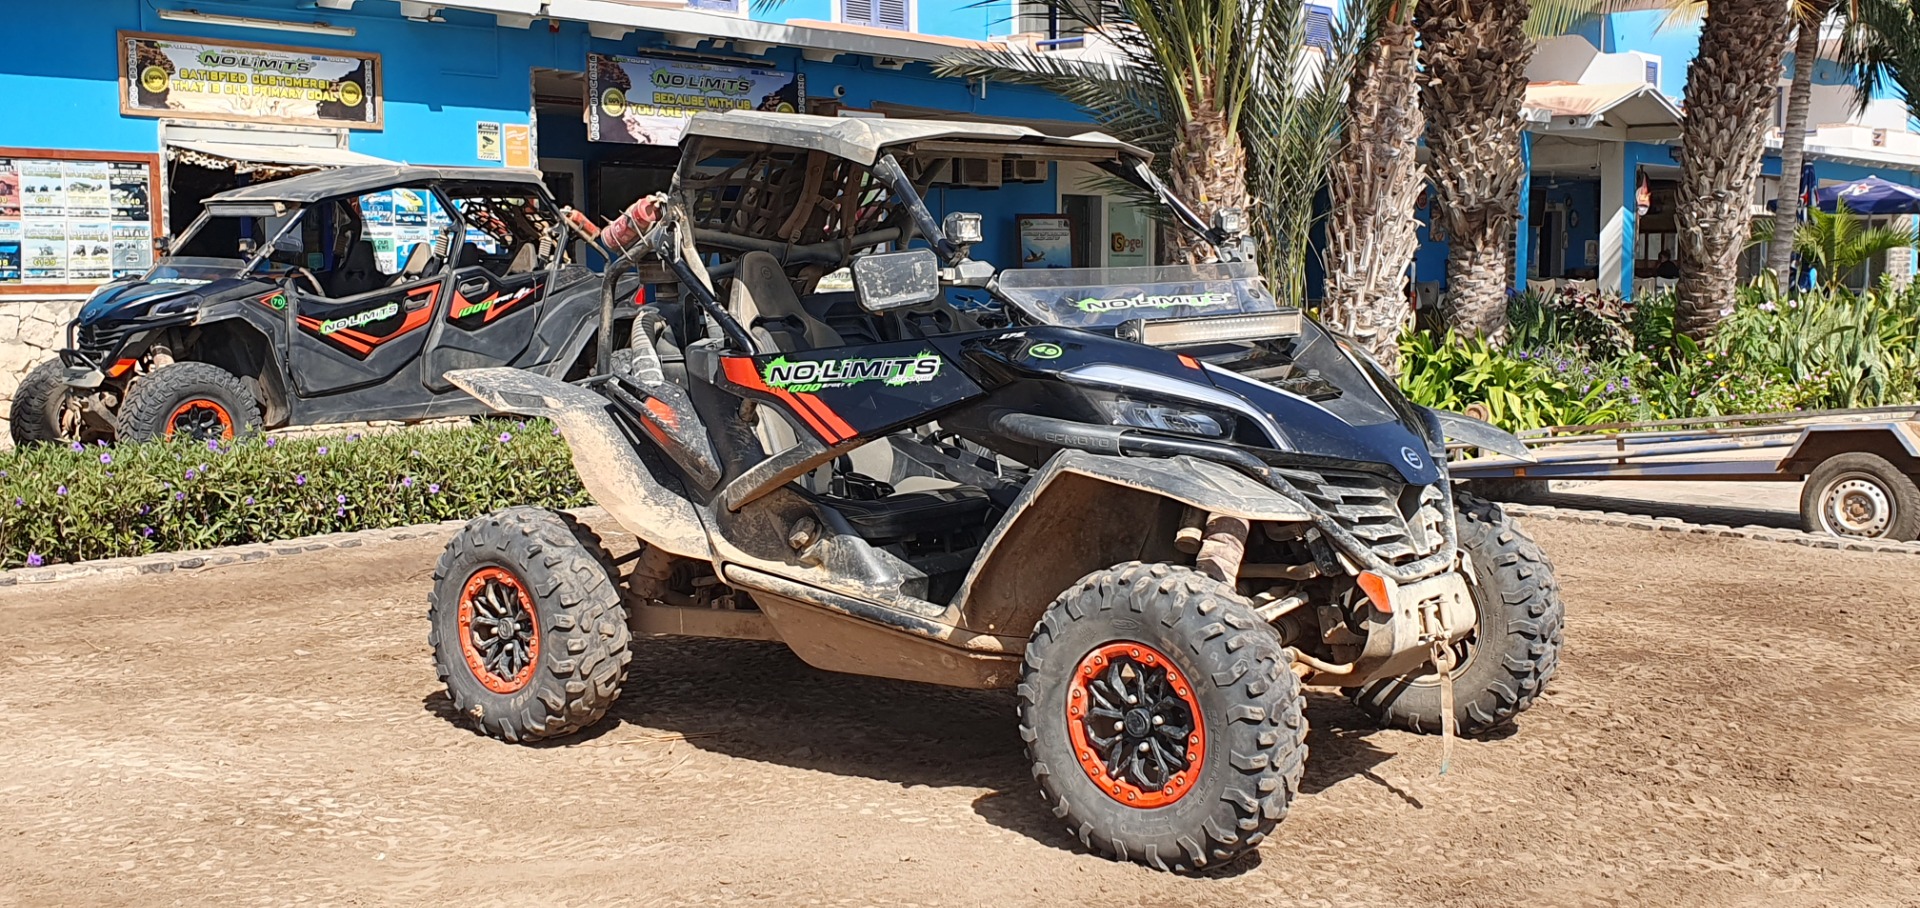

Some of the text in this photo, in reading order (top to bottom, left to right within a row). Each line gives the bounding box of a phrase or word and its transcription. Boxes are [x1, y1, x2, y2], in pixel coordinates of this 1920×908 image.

[203, 54, 237, 66] NO
[180, 68, 329, 89] SATISFIED CUSTOMERS!
[656, 73, 687, 86] NO
[172, 79, 338, 102] THAT IS OUR PRIMARY GOAL
[653, 92, 752, 110] BECAUSE WITH US
[629, 103, 654, 117] YOU
[657, 106, 683, 118] ARE
[1112, 234, 1144, 253] Sogei
[272, 298, 283, 306] 70
[459, 300, 494, 318] 1000
[1087, 299, 1128, 310] NO
[324, 321, 347, 333] NO
[1033, 346, 1058, 355] 49
[769, 364, 816, 383] NO
[788, 383, 822, 393] 1000
[1045, 432, 1110, 449] CFMOTO
